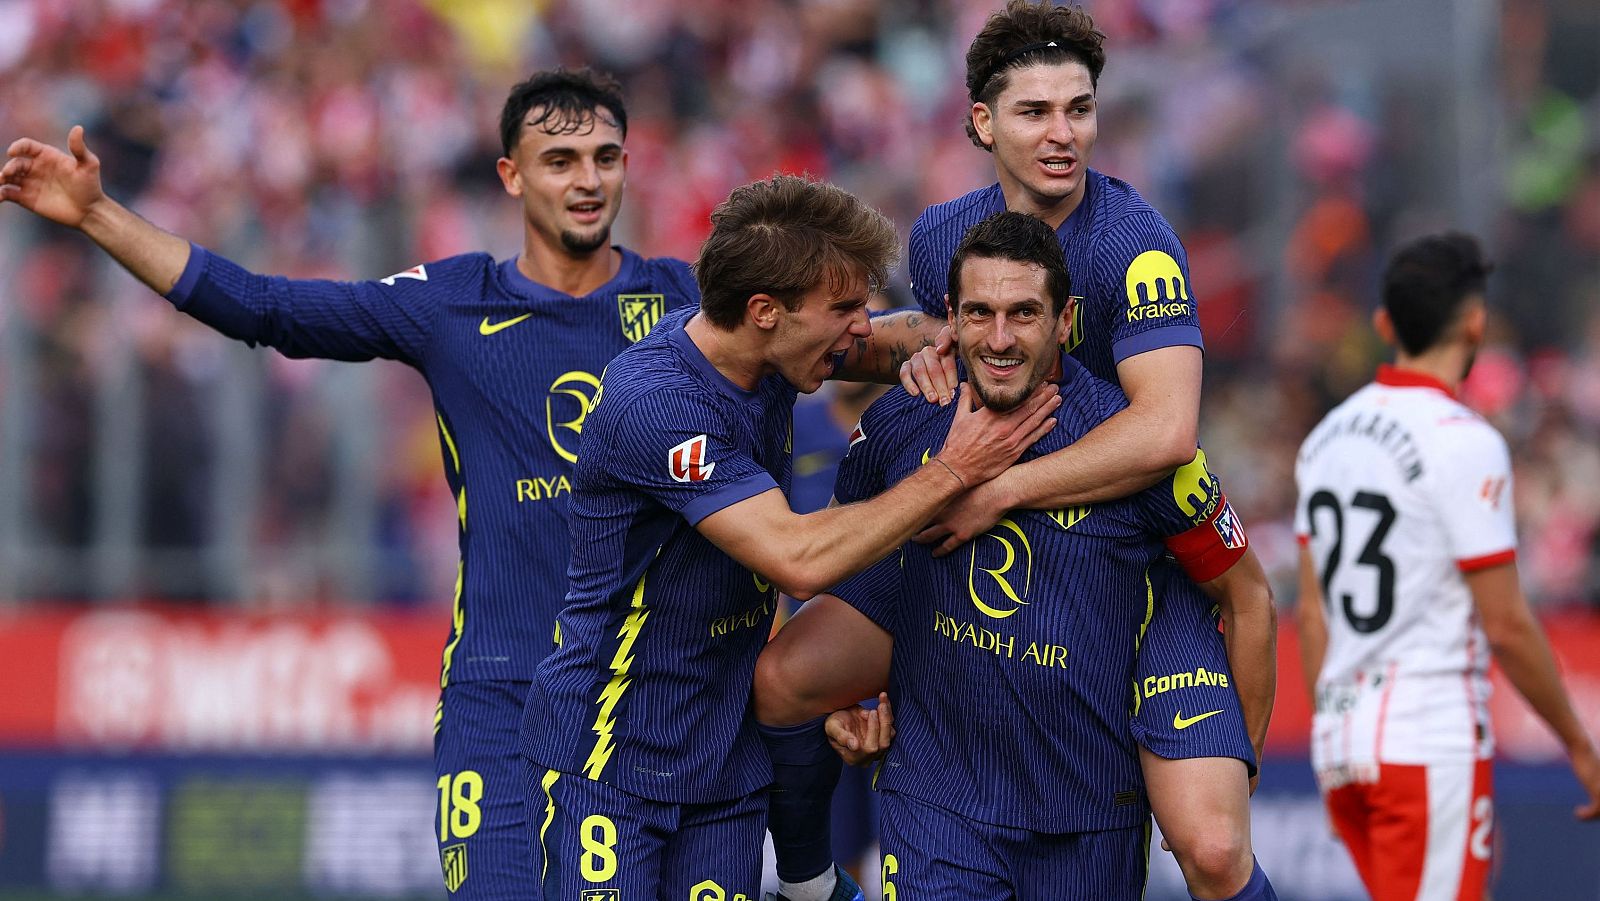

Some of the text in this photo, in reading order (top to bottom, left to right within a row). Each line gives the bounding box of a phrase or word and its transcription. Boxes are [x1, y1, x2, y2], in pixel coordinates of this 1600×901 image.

[1126, 302, 1191, 323] kraken
[516, 475, 572, 503] RIYA
[1308, 490, 1396, 633] 23
[934, 610, 1068, 669] RIYADH AIR
[1144, 667, 1229, 699] ComAve
[437, 770, 484, 843] 18
[580, 814, 618, 883] 8
